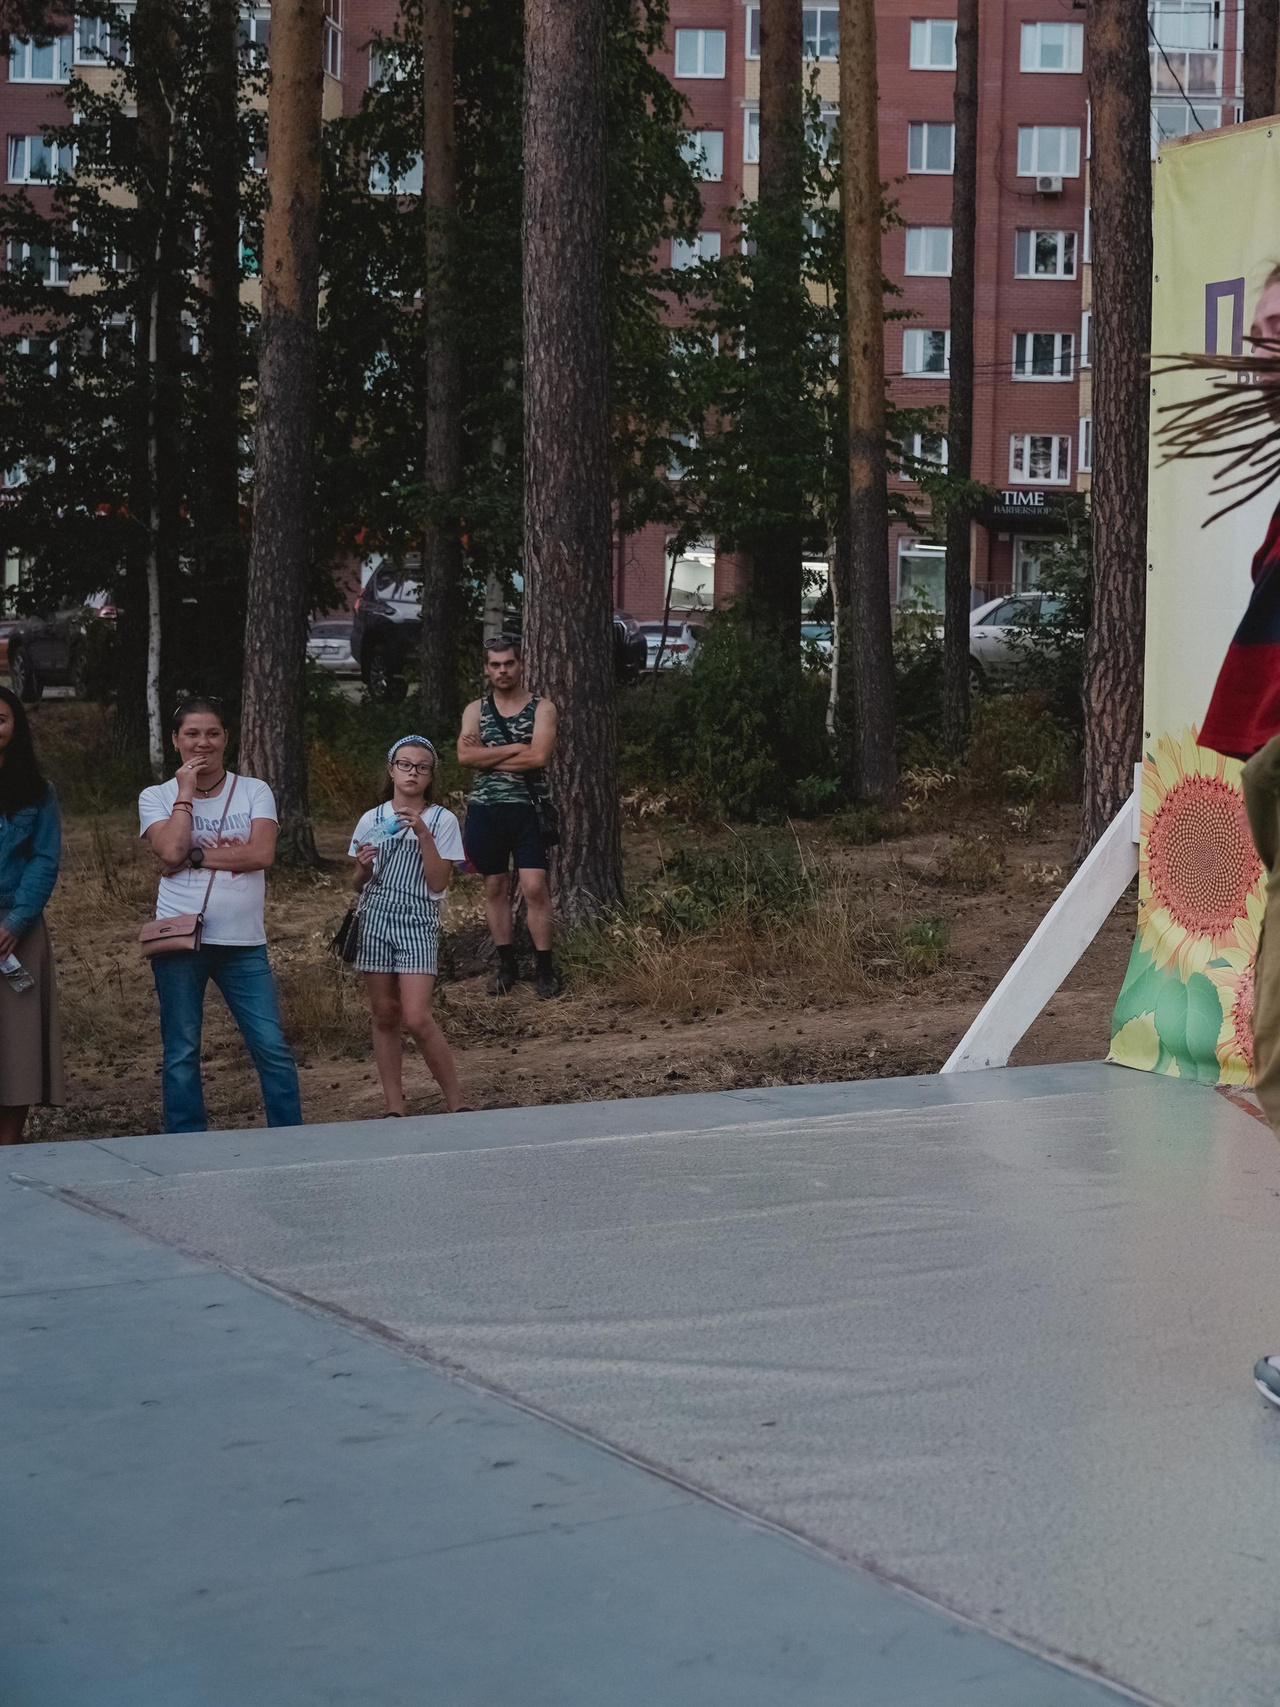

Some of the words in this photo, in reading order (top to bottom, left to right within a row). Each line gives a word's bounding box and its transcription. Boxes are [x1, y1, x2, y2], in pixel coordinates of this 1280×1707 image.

[1001, 490, 1044, 506] TIME
[993, 505, 1052, 515] BARBERSHOP
[190, 812, 251, 833] OSCHINO
